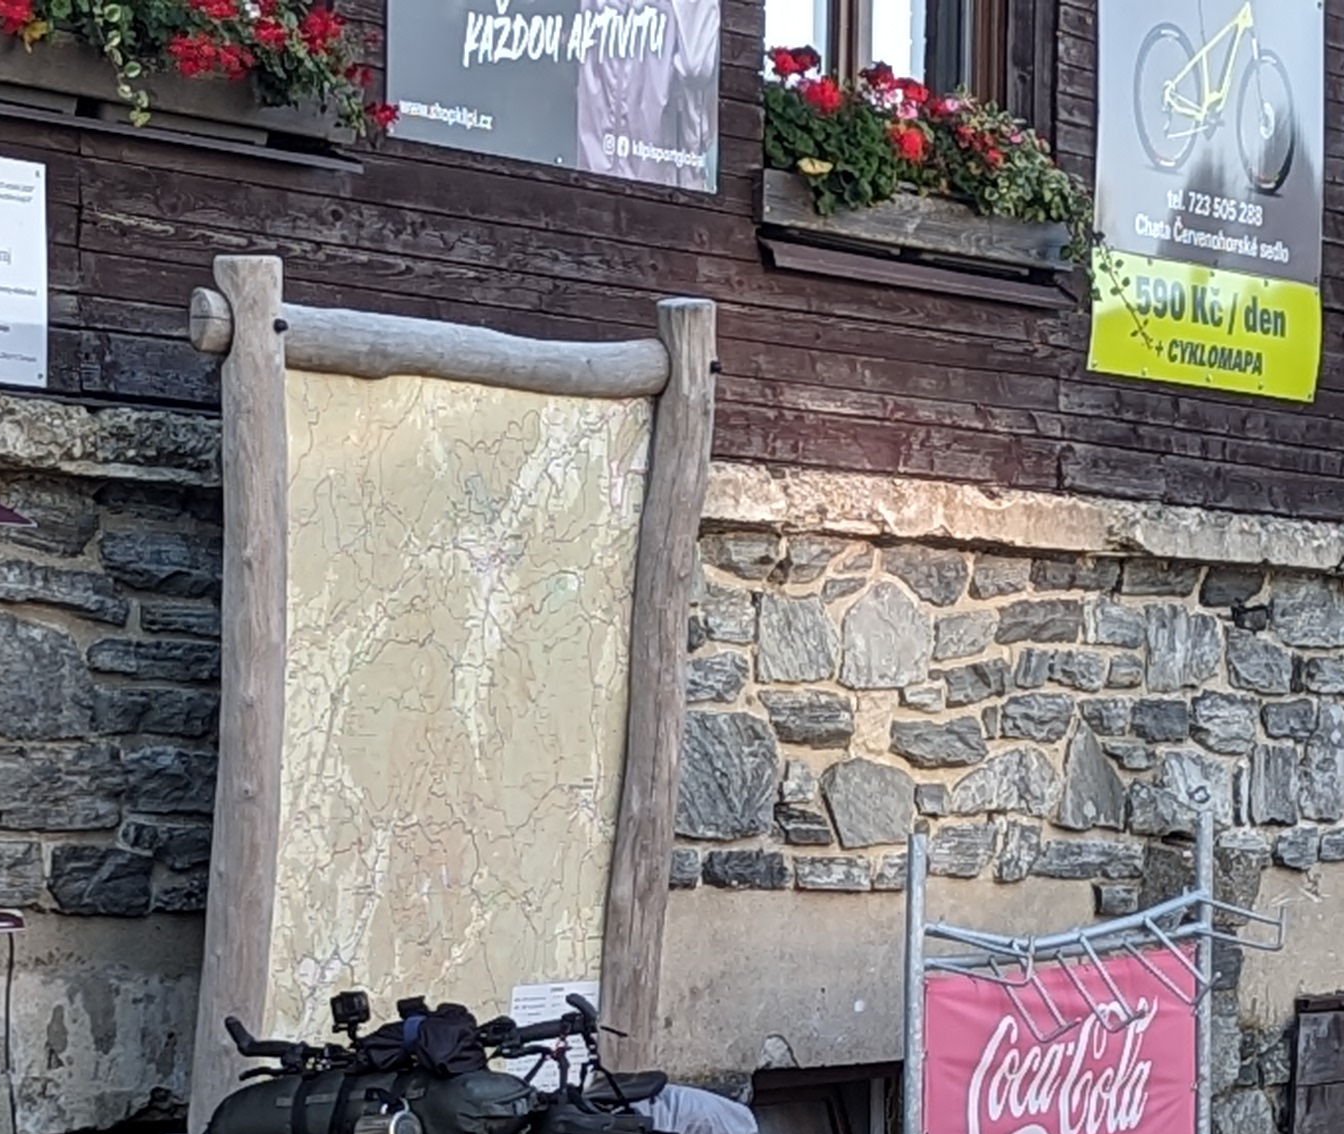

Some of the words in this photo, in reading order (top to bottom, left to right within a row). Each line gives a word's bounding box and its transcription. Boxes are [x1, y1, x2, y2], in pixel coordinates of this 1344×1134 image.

[463, 0, 564, 68] KAŽDOU
[567, 4, 668, 64] AKTIVITU
[1167, 192, 1185, 212] tel.
[1188, 192, 1210, 217] 723
[1213, 198, 1237, 222] 505
[1238, 203, 1263, 227] 288
[1135, 215, 1171, 241] Chata
[1173, 216, 1257, 258] Červenohorské
[1260, 239, 1289, 263] sedlo
[1136, 275, 1185, 322] 590
[1191, 287, 1223, 329] Kč
[1243, 297, 1286, 338] den
[1168, 339, 1263, 376] CYKLOMAPA
